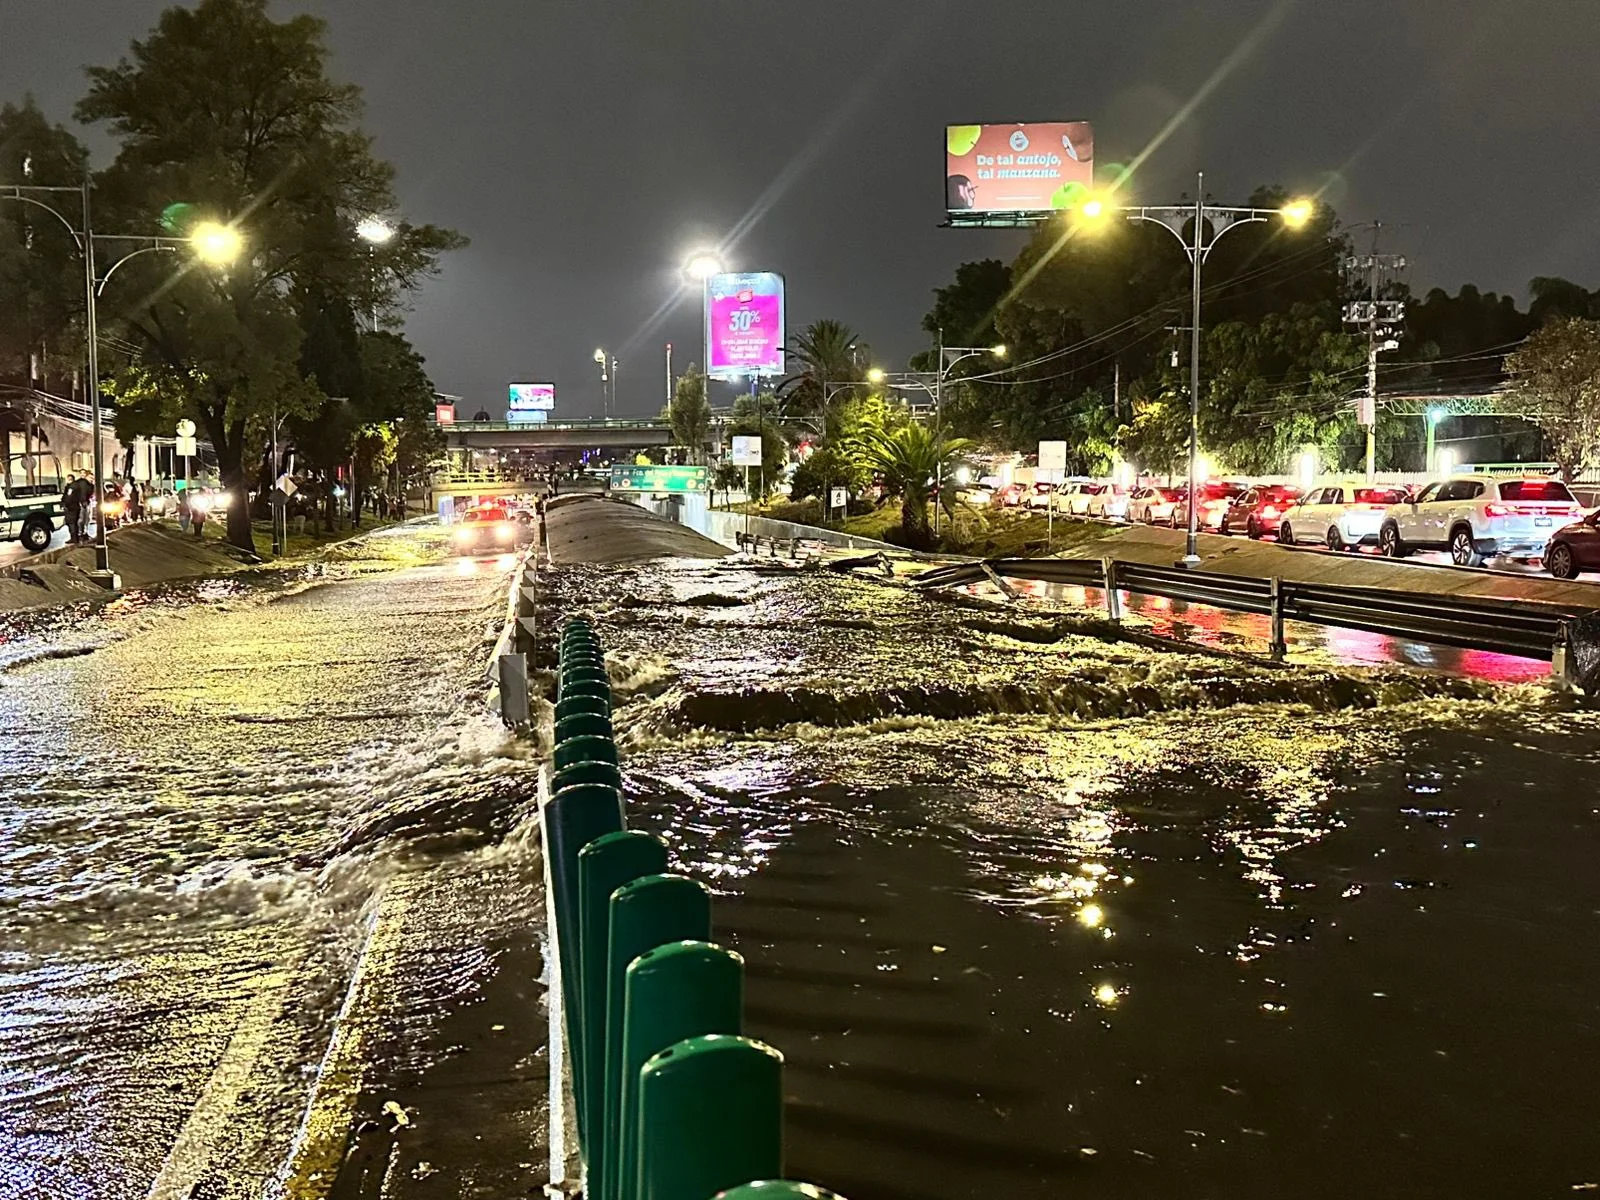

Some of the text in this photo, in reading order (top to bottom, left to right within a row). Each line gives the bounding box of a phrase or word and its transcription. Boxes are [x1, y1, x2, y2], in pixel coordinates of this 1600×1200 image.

[977, 152, 1062, 168] De tal antojo,
[977, 168, 1061, 179] tal manzana.
[729, 310, 761, 332] 30%
